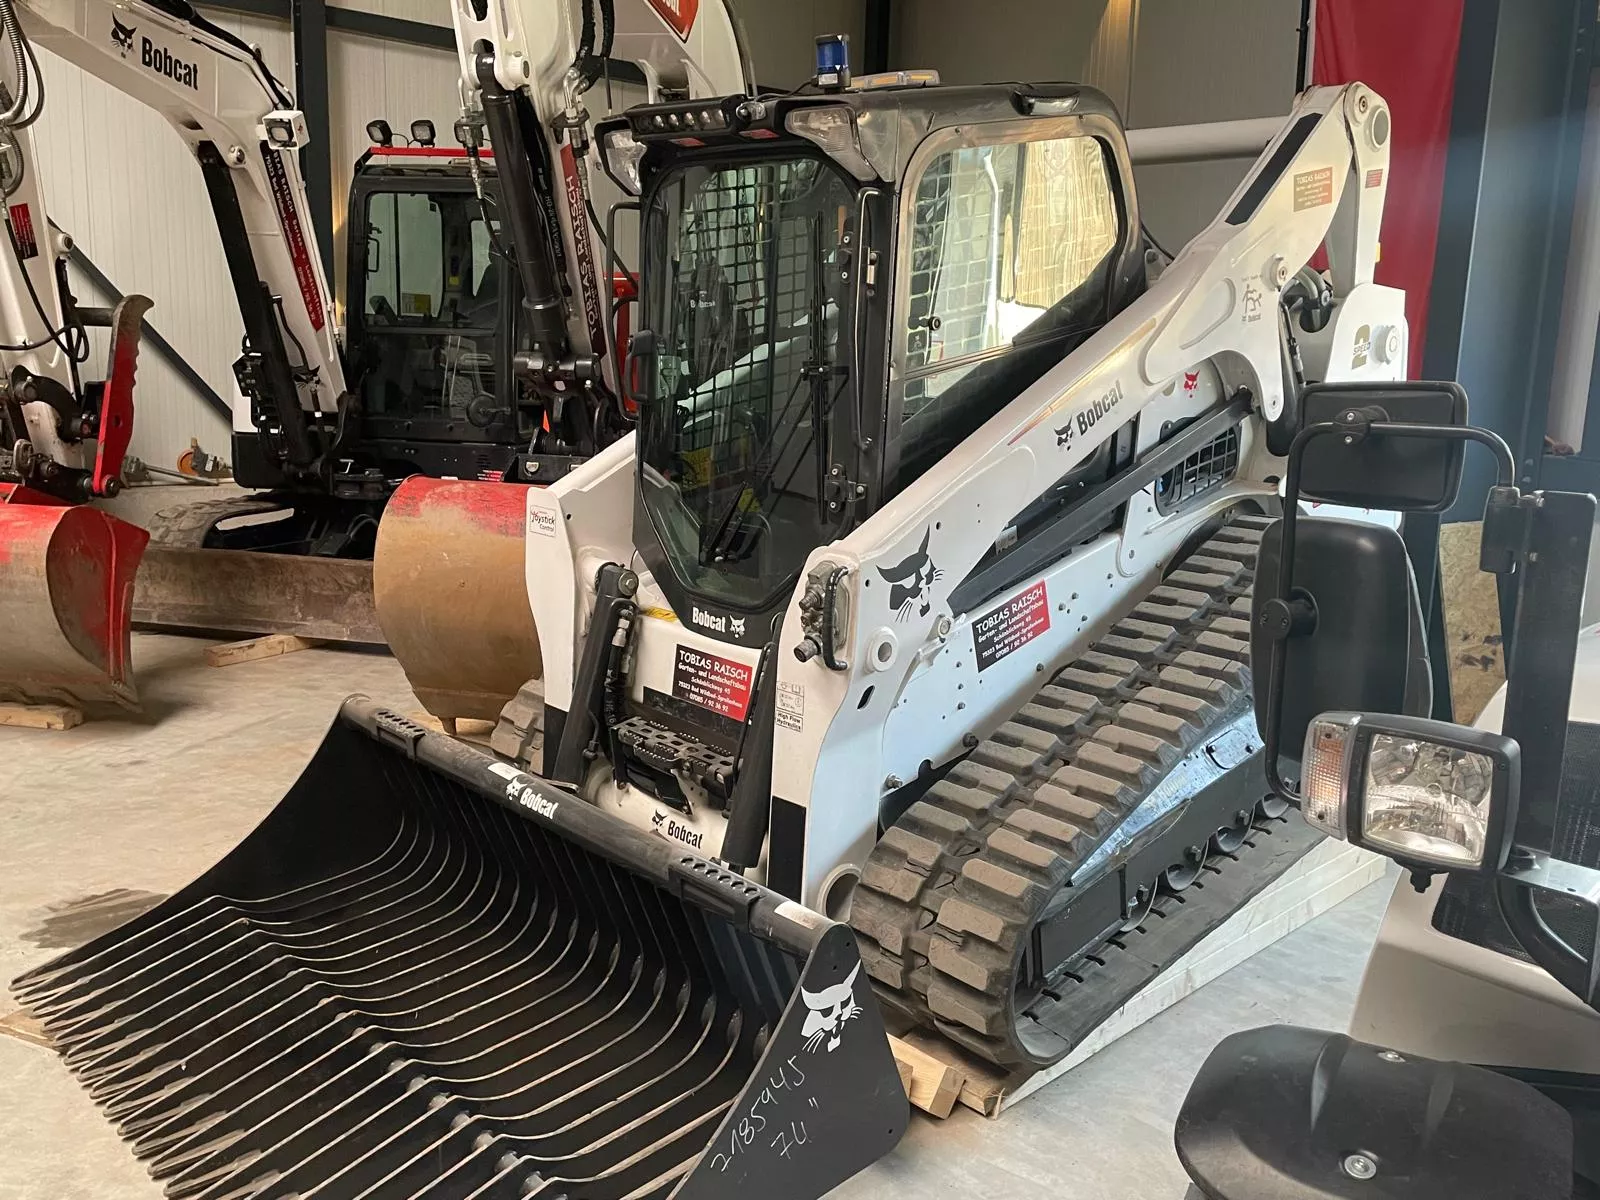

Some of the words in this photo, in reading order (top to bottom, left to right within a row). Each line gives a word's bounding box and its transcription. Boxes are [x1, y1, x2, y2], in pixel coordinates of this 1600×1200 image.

[142, 36, 198, 90] Bobcat
[566, 176, 582, 256] RAISCH
[580, 261, 597, 339] TOBIAS
[1077, 380, 1123, 435] Bobcat
[531, 512, 554, 525] Joystick
[692, 606, 726, 633] Bobcat
[976, 608, 1010, 634] TOBIAS
[1011, 586, 1043, 614] RAISCH
[978, 629, 997, 643] Garten-
[999, 620, 1008, 631] und
[1008, 599, 1043, 624] Landschaftsbau
[995, 641, 1004, 650] Bad
[678, 662, 697, 673] Garten-
[698, 670, 707, 678] und
[708, 672, 746, 691] Landschaftsbau
[680, 650, 711, 669] TOBIAS
[714, 661, 748, 681] RAISCH
[691, 685, 699, 693] Bad
[722, 704, 728, 712] 92
[520, 787, 559, 820] Bobcat
[668, 820, 703, 850] Bobcat
